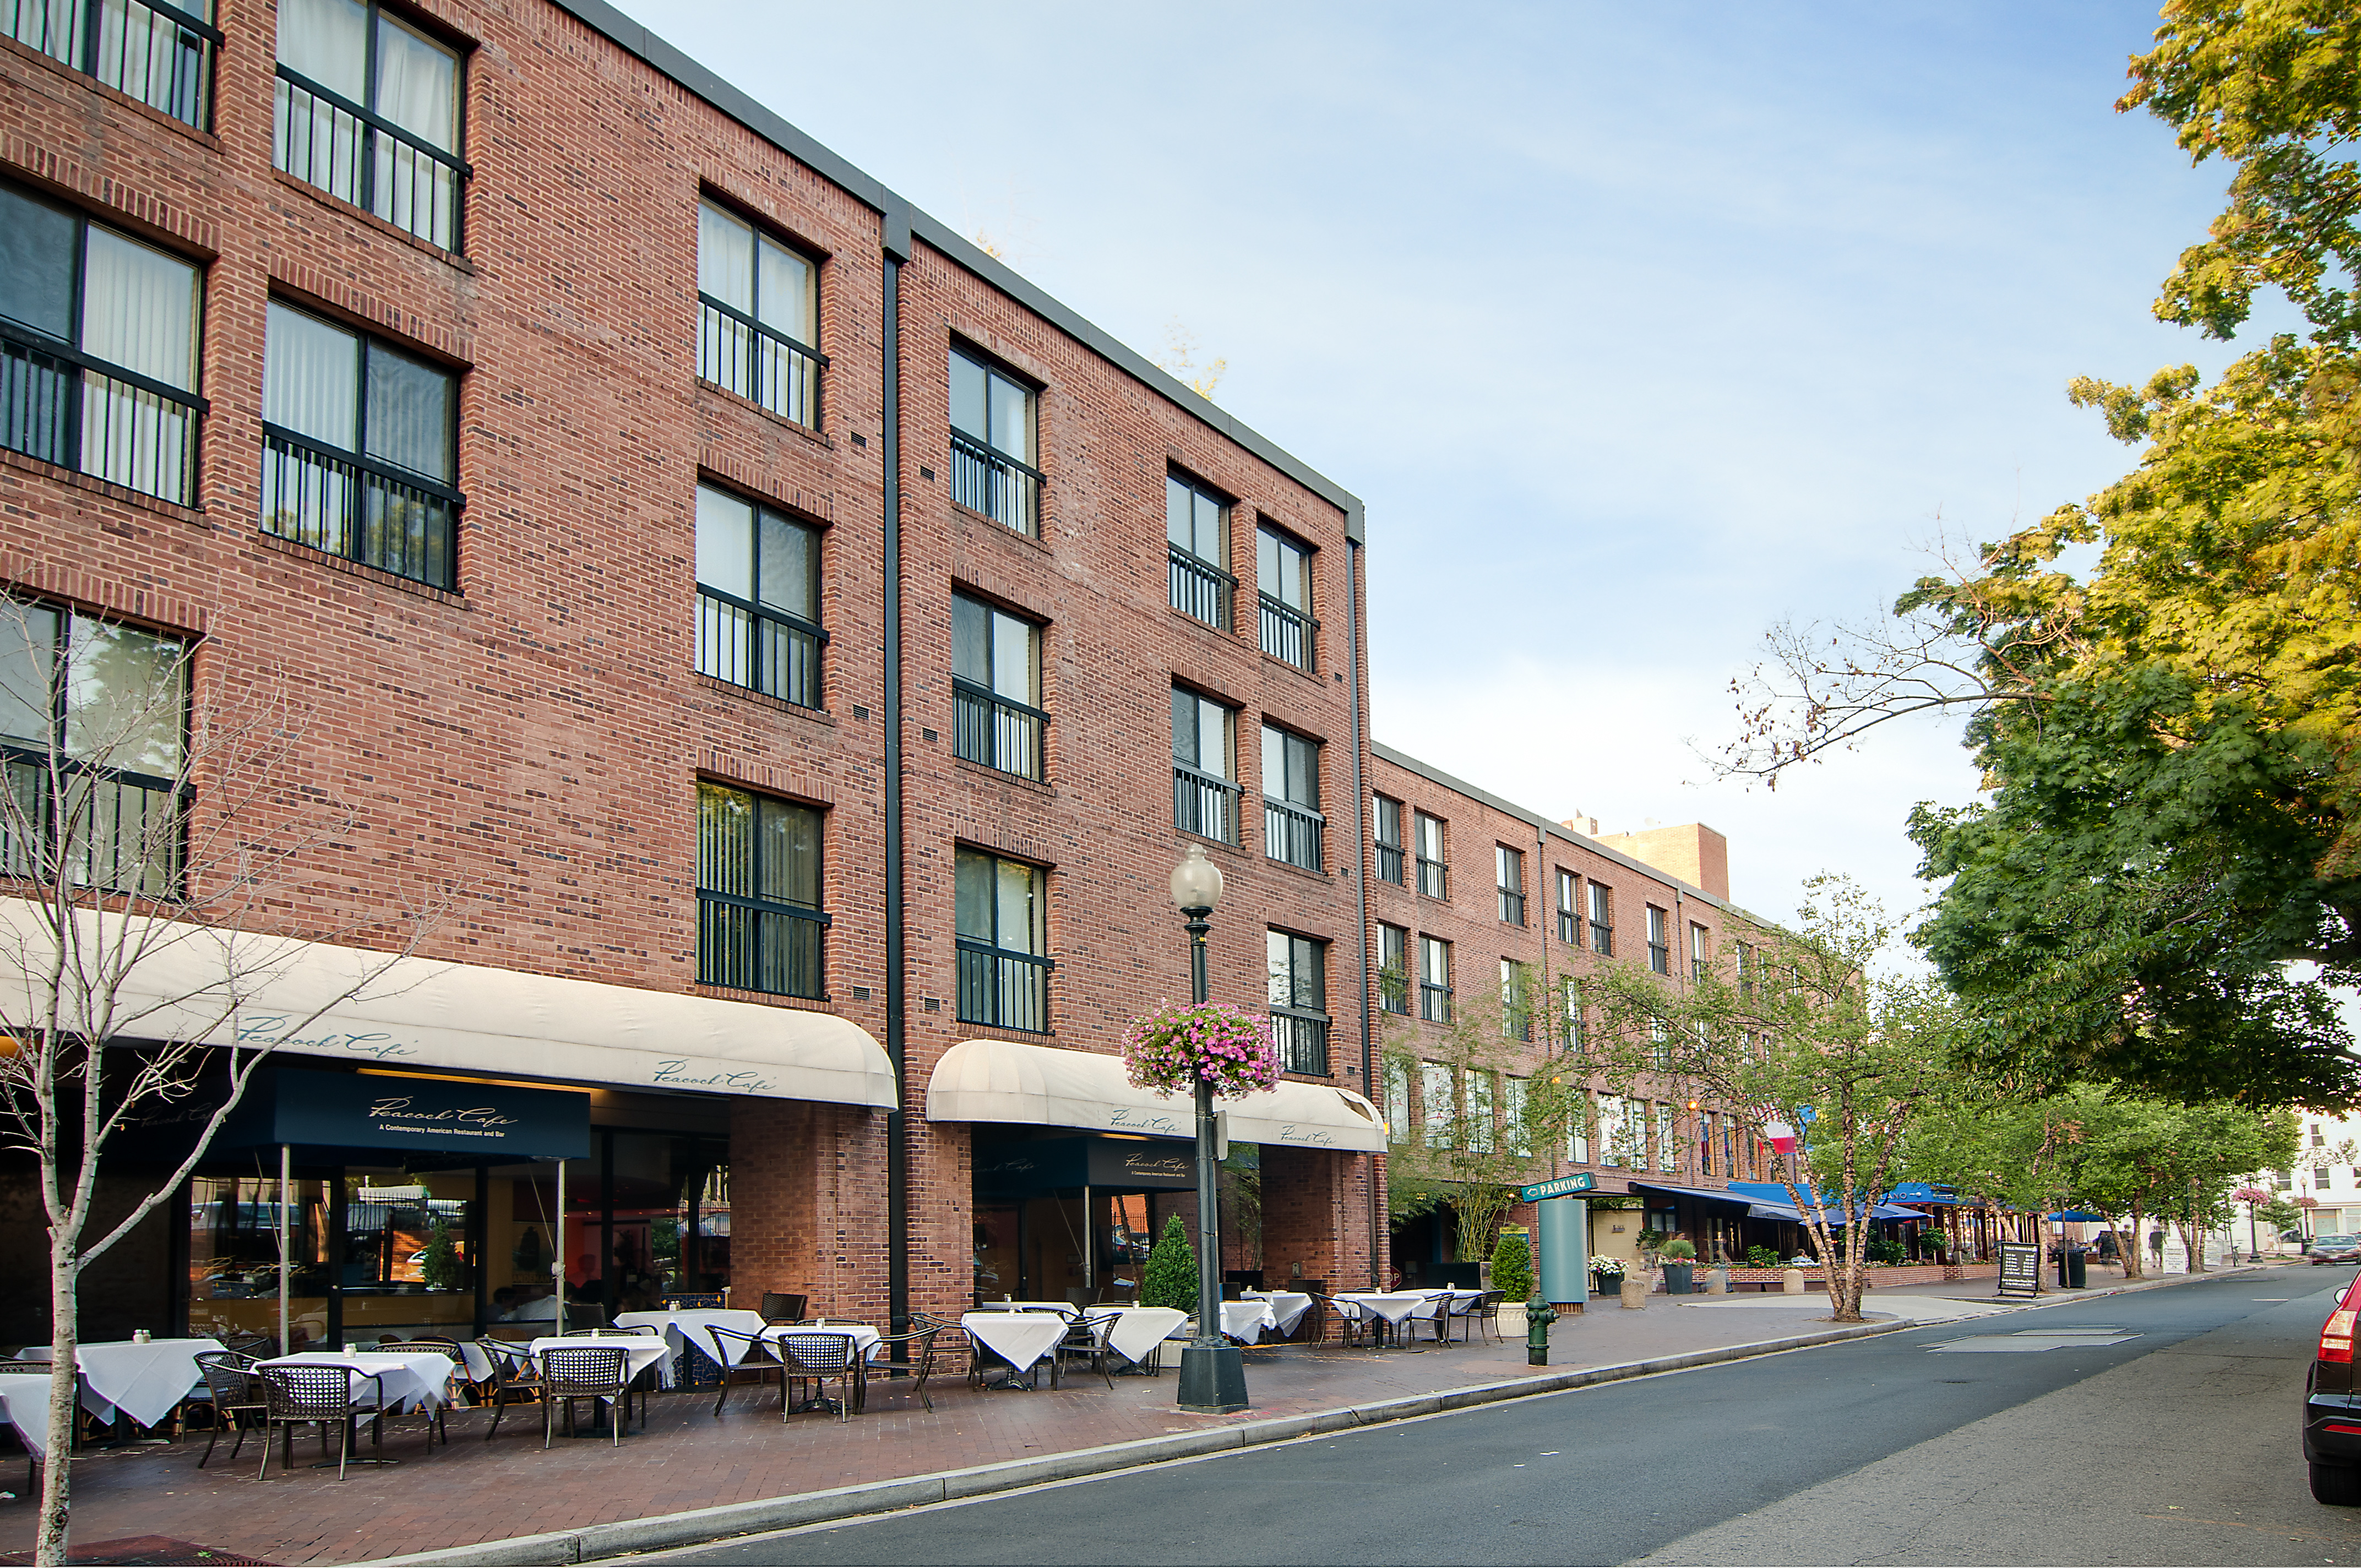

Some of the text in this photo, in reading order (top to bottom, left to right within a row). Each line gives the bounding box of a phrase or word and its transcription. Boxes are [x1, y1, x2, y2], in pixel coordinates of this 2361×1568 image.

[238, 1015, 418, 1059] Peacock Café
[654, 1059, 777, 1093] Peacock Café
[188, 1103, 216, 1124] Caf
[369, 1096, 518, 1128] Peacock Cafe
[1111, 1108, 1181, 1134] Peacock Café
[385, 1124, 426, 1134] Contemporary
[1281, 1124, 1336, 1146] Peacock Café
[1125, 1151, 1162, 1167] Peacock
[1539, 1177, 1586, 1196] PARKING
